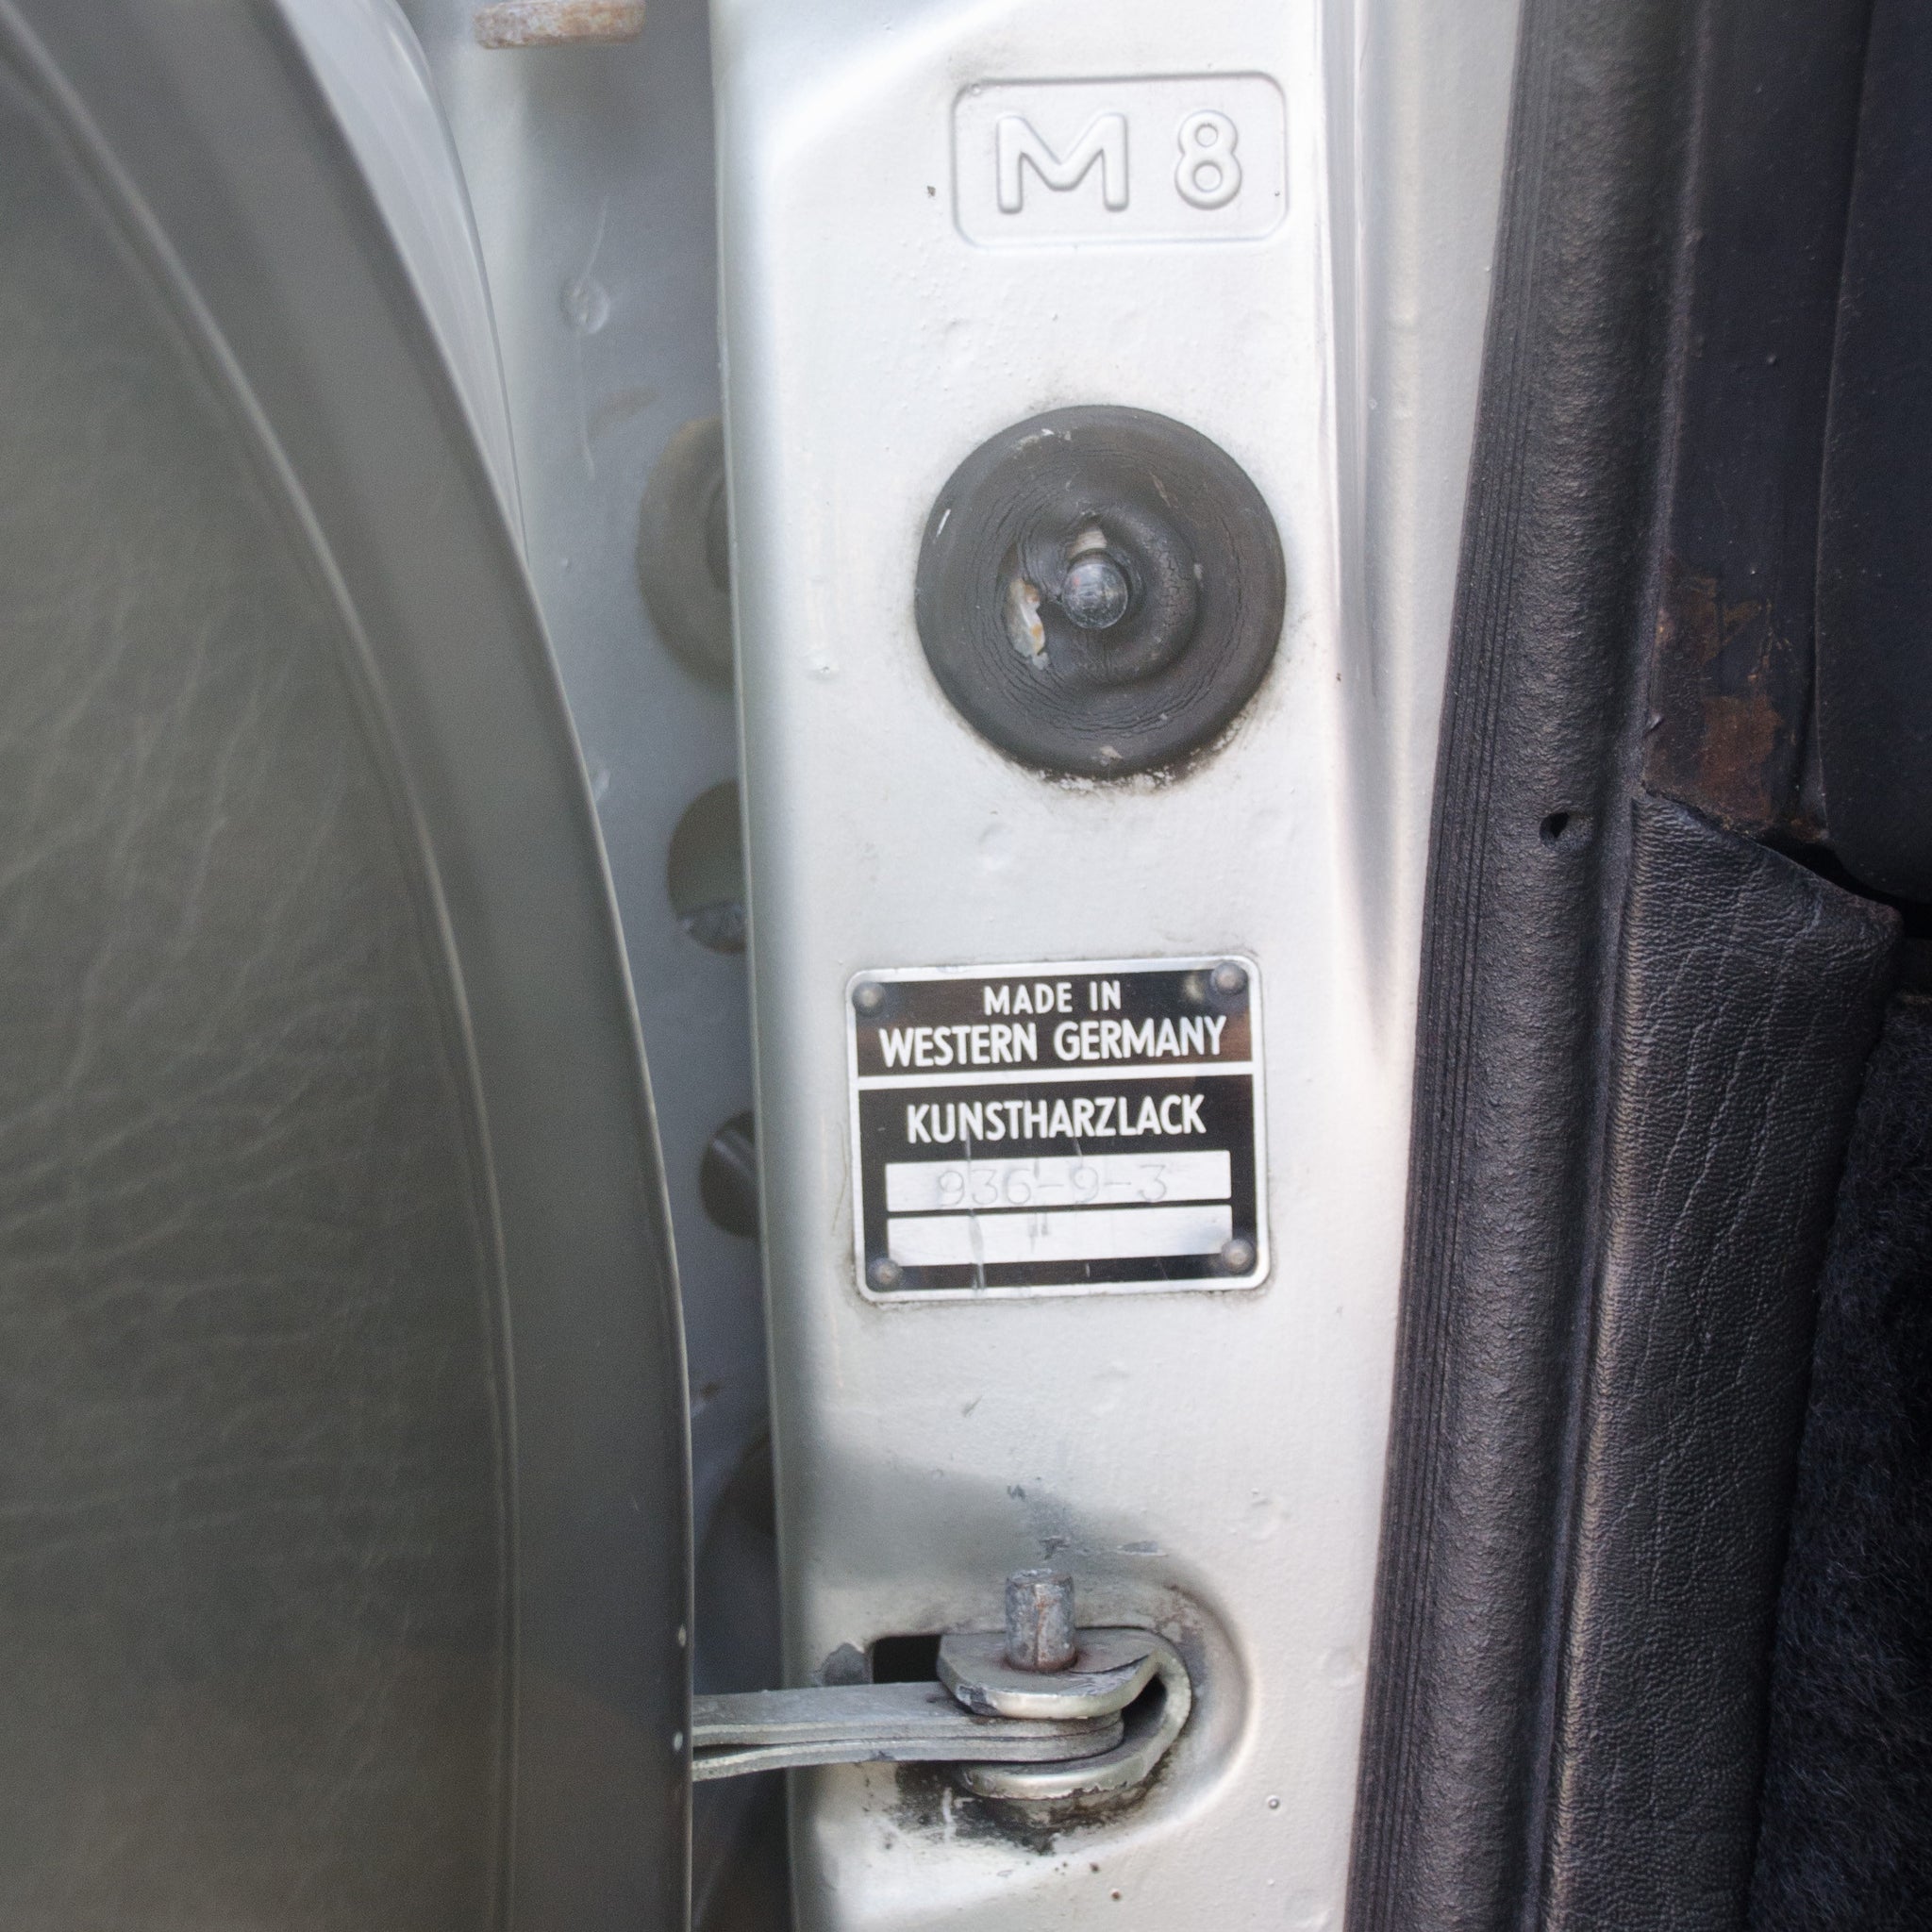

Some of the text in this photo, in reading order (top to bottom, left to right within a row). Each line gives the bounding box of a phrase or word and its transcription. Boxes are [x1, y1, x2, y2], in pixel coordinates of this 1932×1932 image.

[996, 109, 1242, 214] M 8
[984, 980, 1121, 1015] MADE IN
[878, 1016, 1226, 1067] WESTERN GERMANY
[907, 1094, 1207, 1143] KUNSTHARZLACK
[938, 1163, 1168, 1207] 936-9-3
